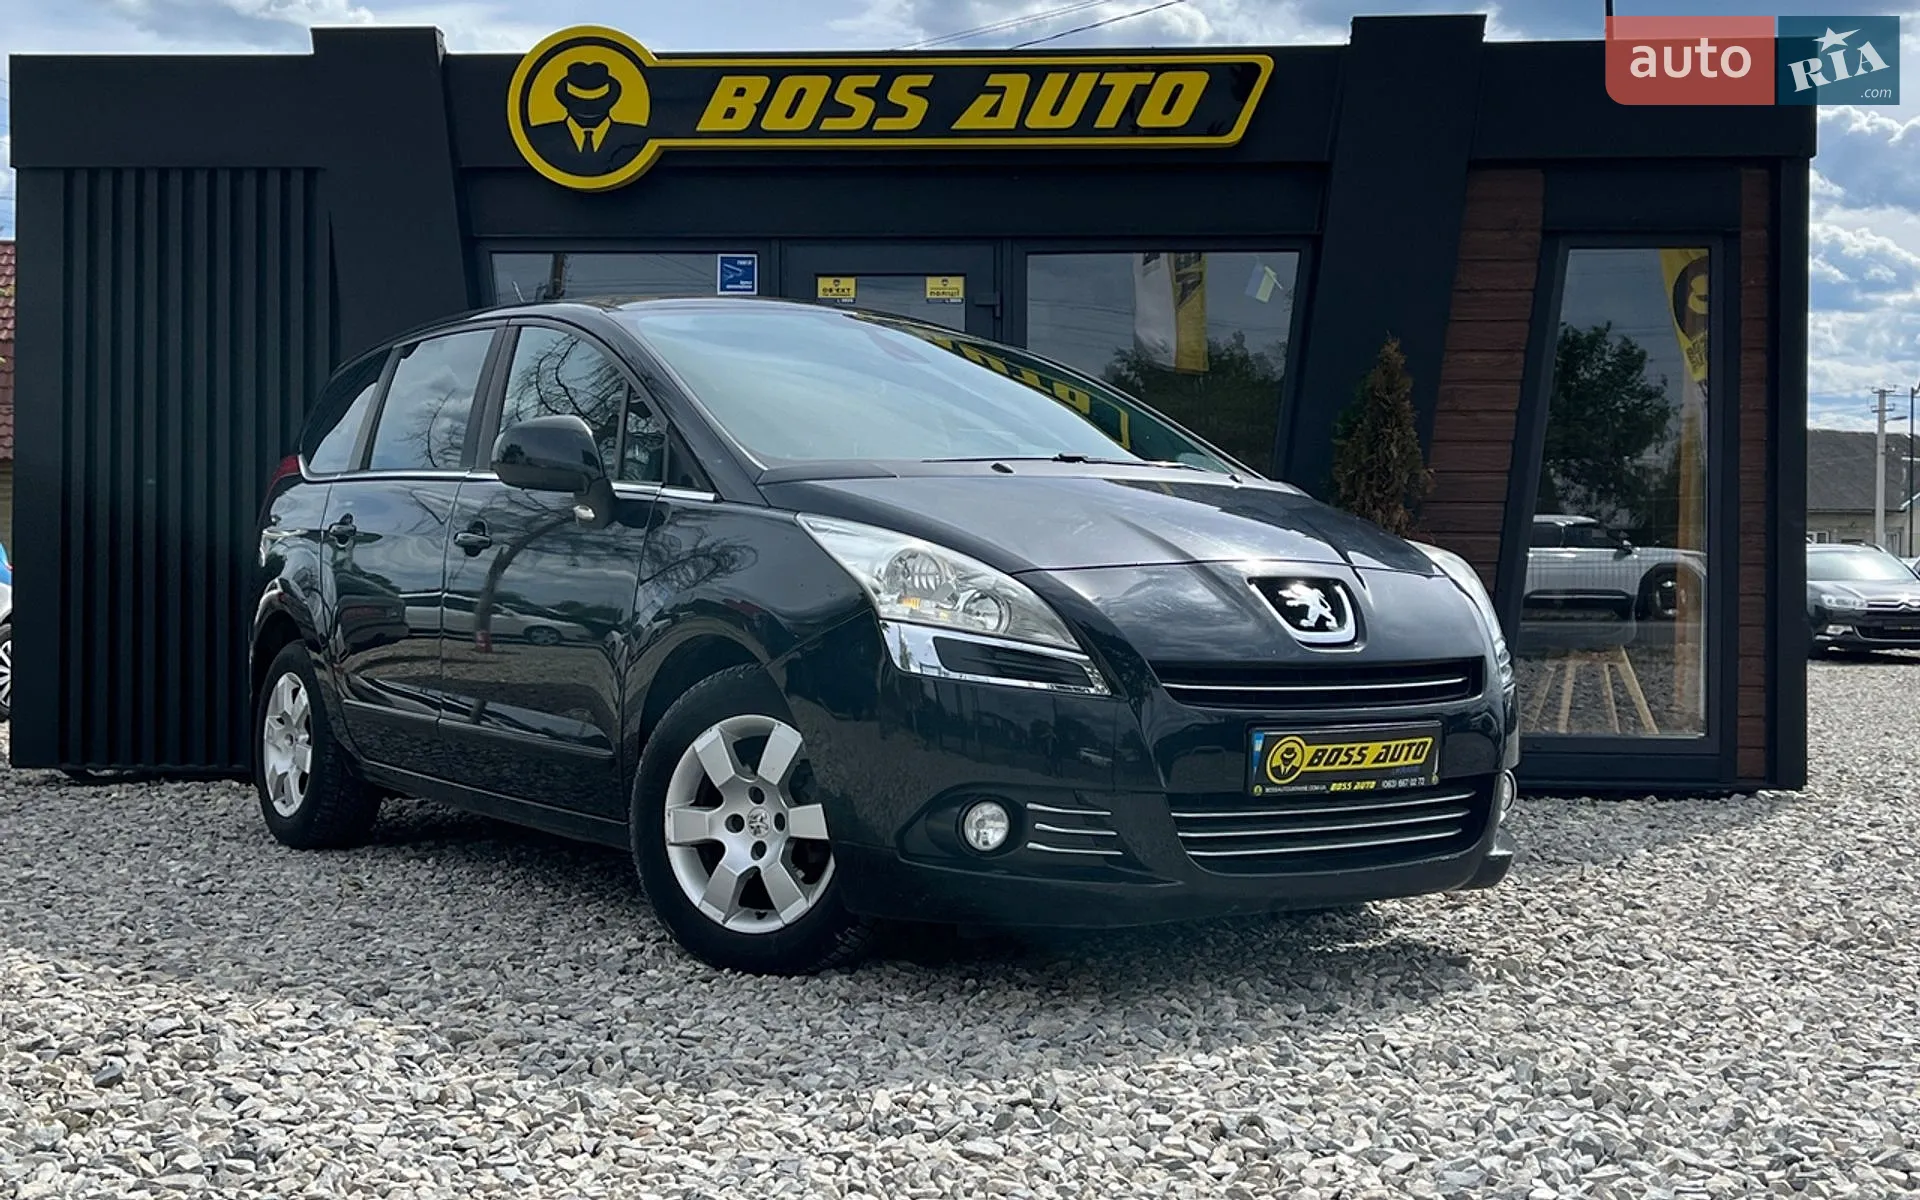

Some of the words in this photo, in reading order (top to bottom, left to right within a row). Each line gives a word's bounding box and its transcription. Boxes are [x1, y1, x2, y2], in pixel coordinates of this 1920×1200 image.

[696, 74, 934, 132] BOSS
[951, 71, 1211, 131] AUTO
[1306, 746, 1369, 767] BOSS
[1373, 741, 1427, 764] AUTO
[1330, 782, 1352, 791] BOSS
[1353, 781, 1376, 790] AUTO
